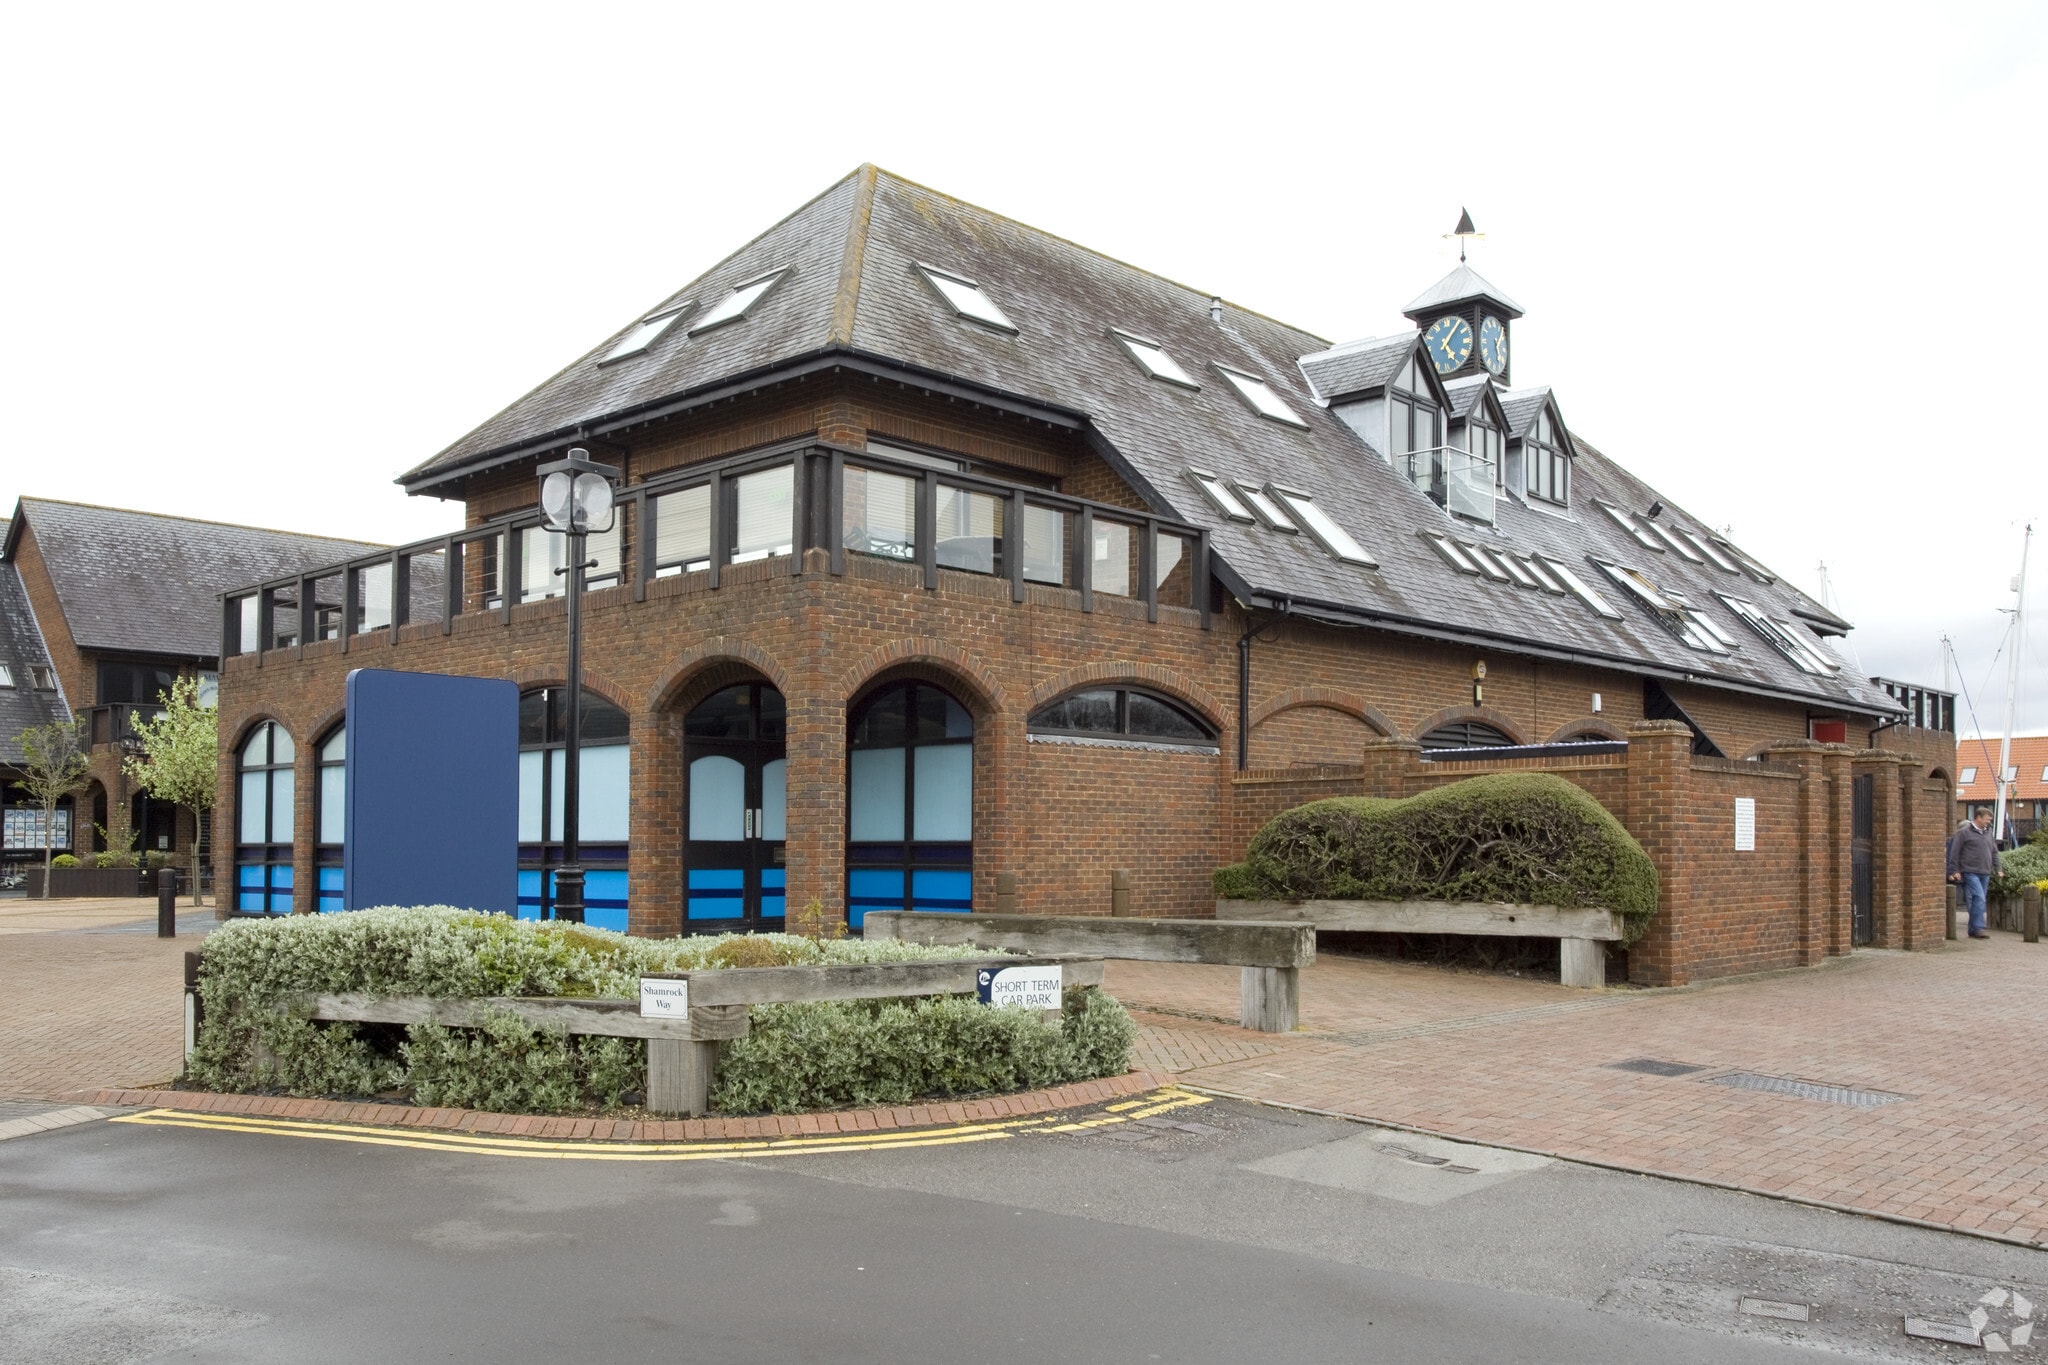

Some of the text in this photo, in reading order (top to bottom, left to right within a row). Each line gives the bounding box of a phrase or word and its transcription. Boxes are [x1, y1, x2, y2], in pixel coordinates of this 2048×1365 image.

[643, 986, 683, 997] Shamrock
[994, 979, 1059, 993] SHORT TERM
[656, 999, 671, 1010] Way
[1001, 993, 1052, 1006] CAR PARK
